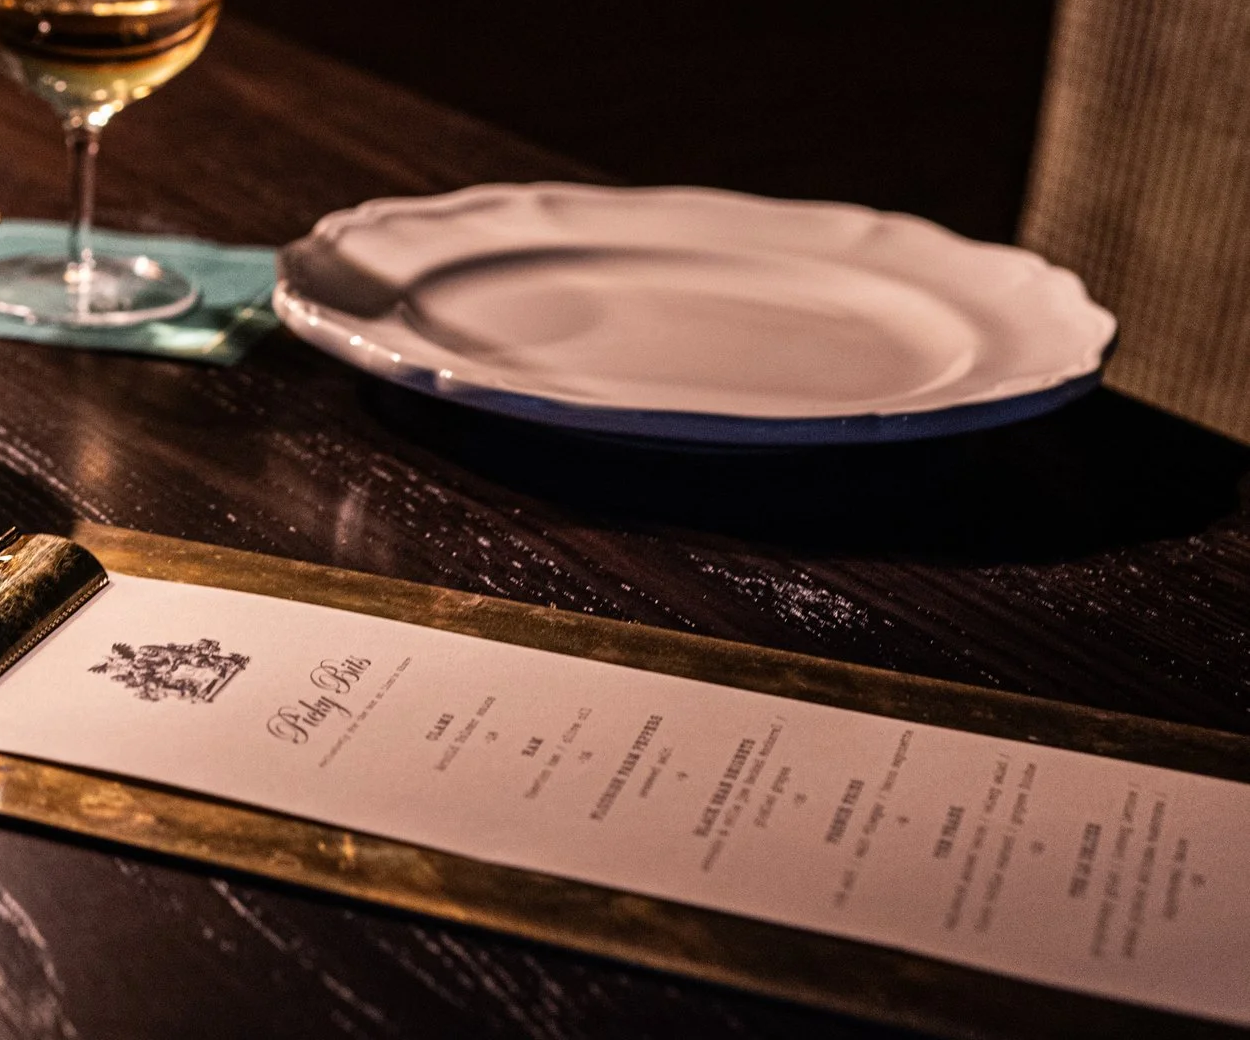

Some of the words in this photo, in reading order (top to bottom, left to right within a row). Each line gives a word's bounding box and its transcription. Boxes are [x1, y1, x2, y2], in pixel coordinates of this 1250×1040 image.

[308, 654, 372, 694] Bits
[265, 695, 352, 745] Picky
[424, 712, 455, 741] CLAMS
[520, 735, 544, 757] HAM
